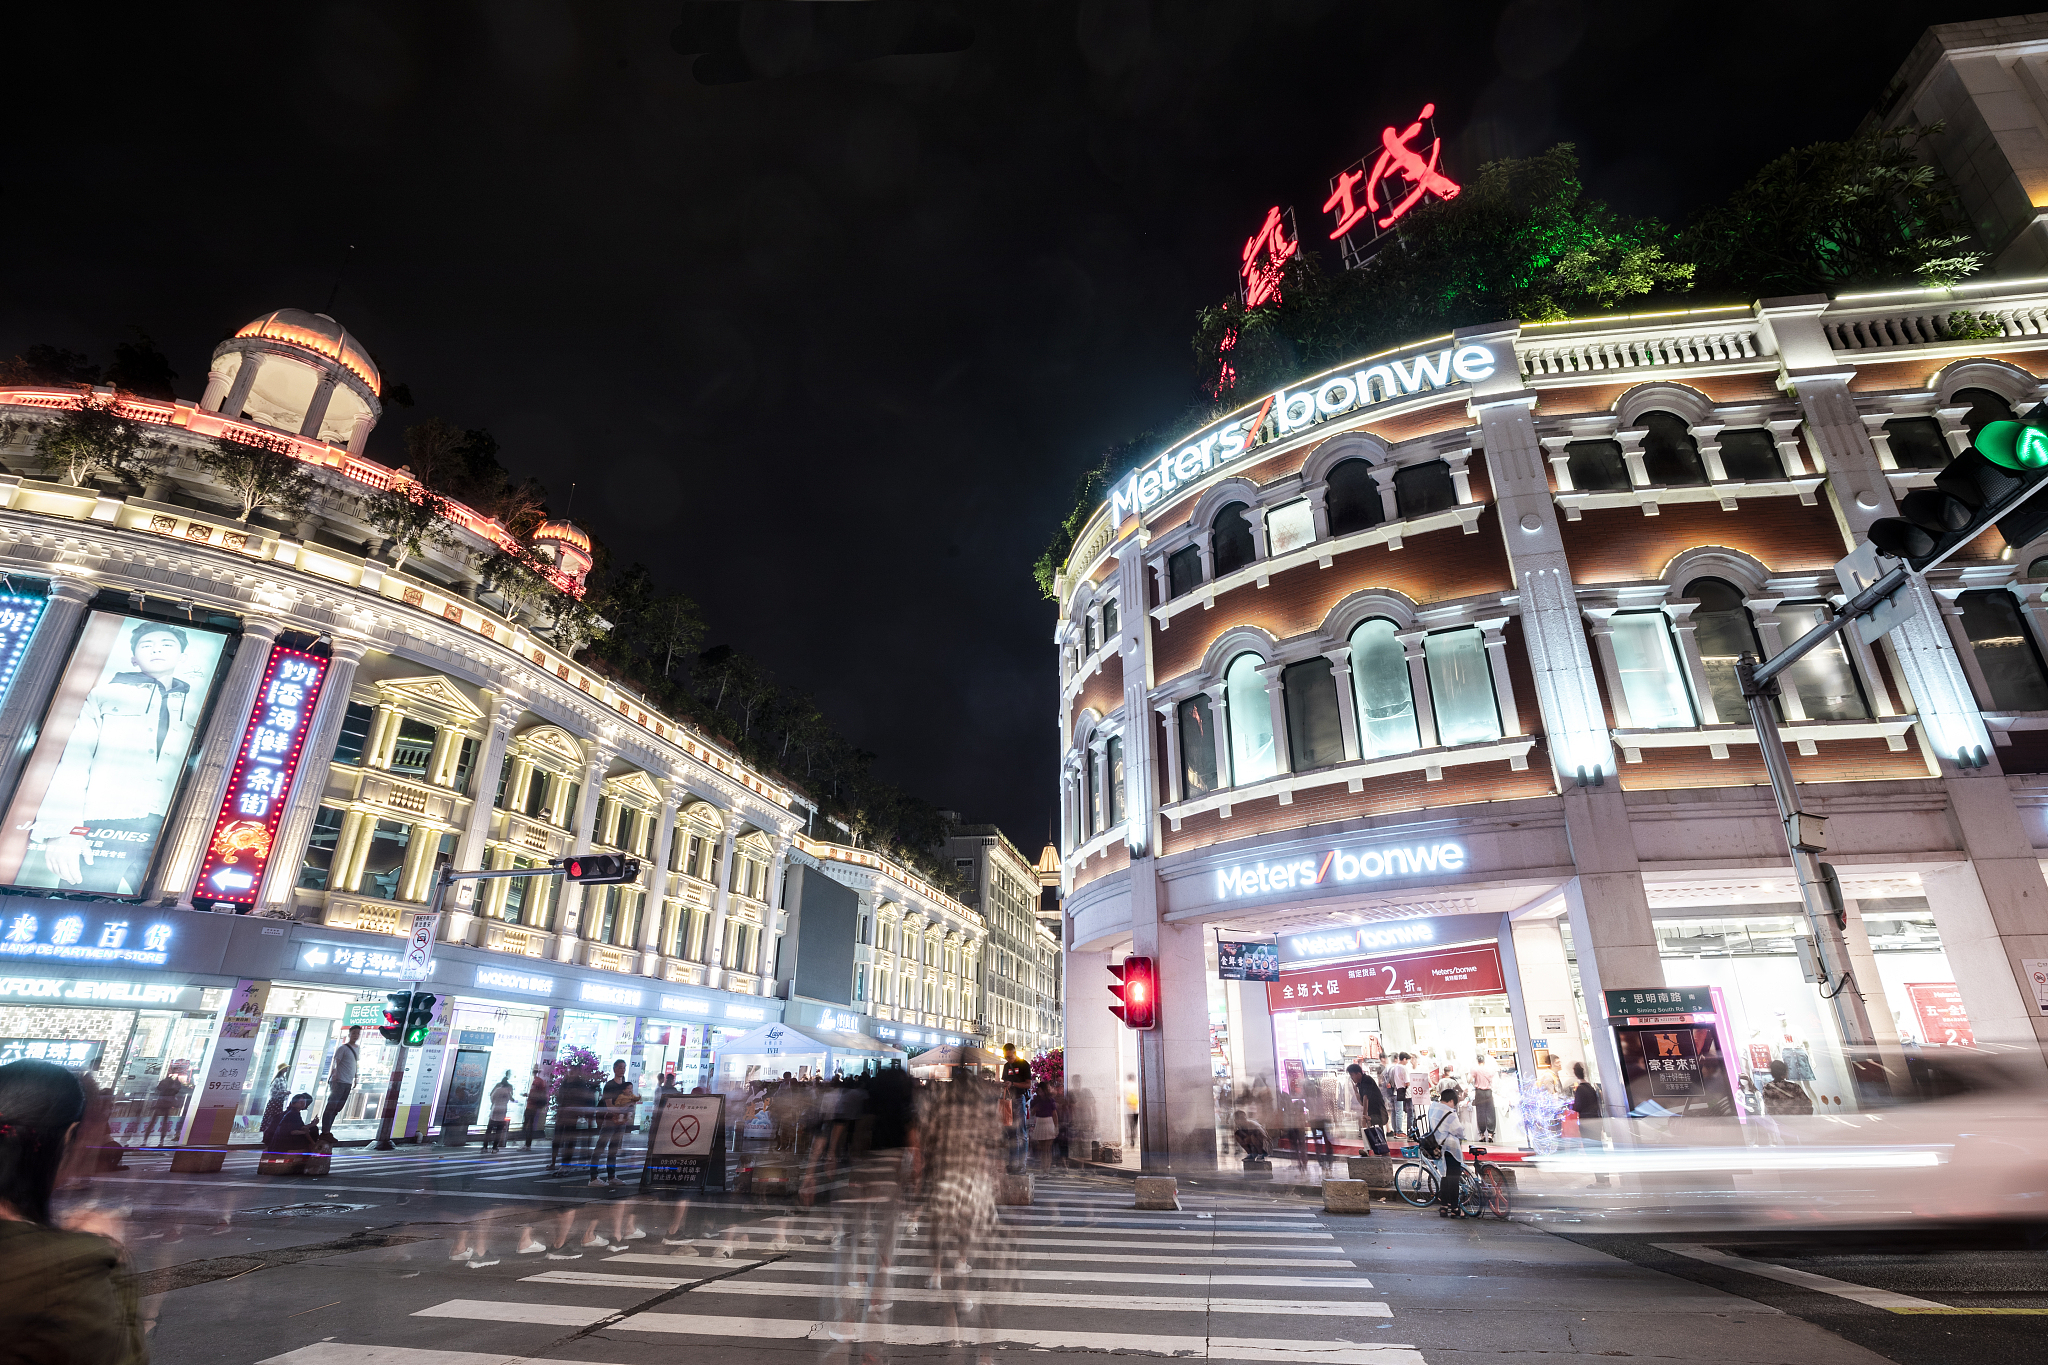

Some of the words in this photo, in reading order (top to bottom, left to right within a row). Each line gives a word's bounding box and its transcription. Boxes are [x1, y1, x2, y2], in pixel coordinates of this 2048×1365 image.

[1112, 344, 1496, 530] Meters/bonwe
[88, 828, 151, 843] JONES
[1217, 842, 1464, 898] Meters/bonwe
[4, 913, 172, 951] 来雅百货
[1292, 922, 1434, 956] Meters/bonwe
[1431, 965, 1478, 977] Meters/bonwe
[65, 981, 184, 1003] JEWELLERY
[1282, 979, 1340, 999] 全场大促
[1633, 992, 1682, 1004] 思明南路
[351, 1005, 380, 1018] 屈臣氏
[1, 1042, 91, 1060] 六福珠寶
[218, 1068, 239, 1078] 全场
[208, 1081, 241, 1091] 59元起
[1412, 1086, 1424, 1096] 39
